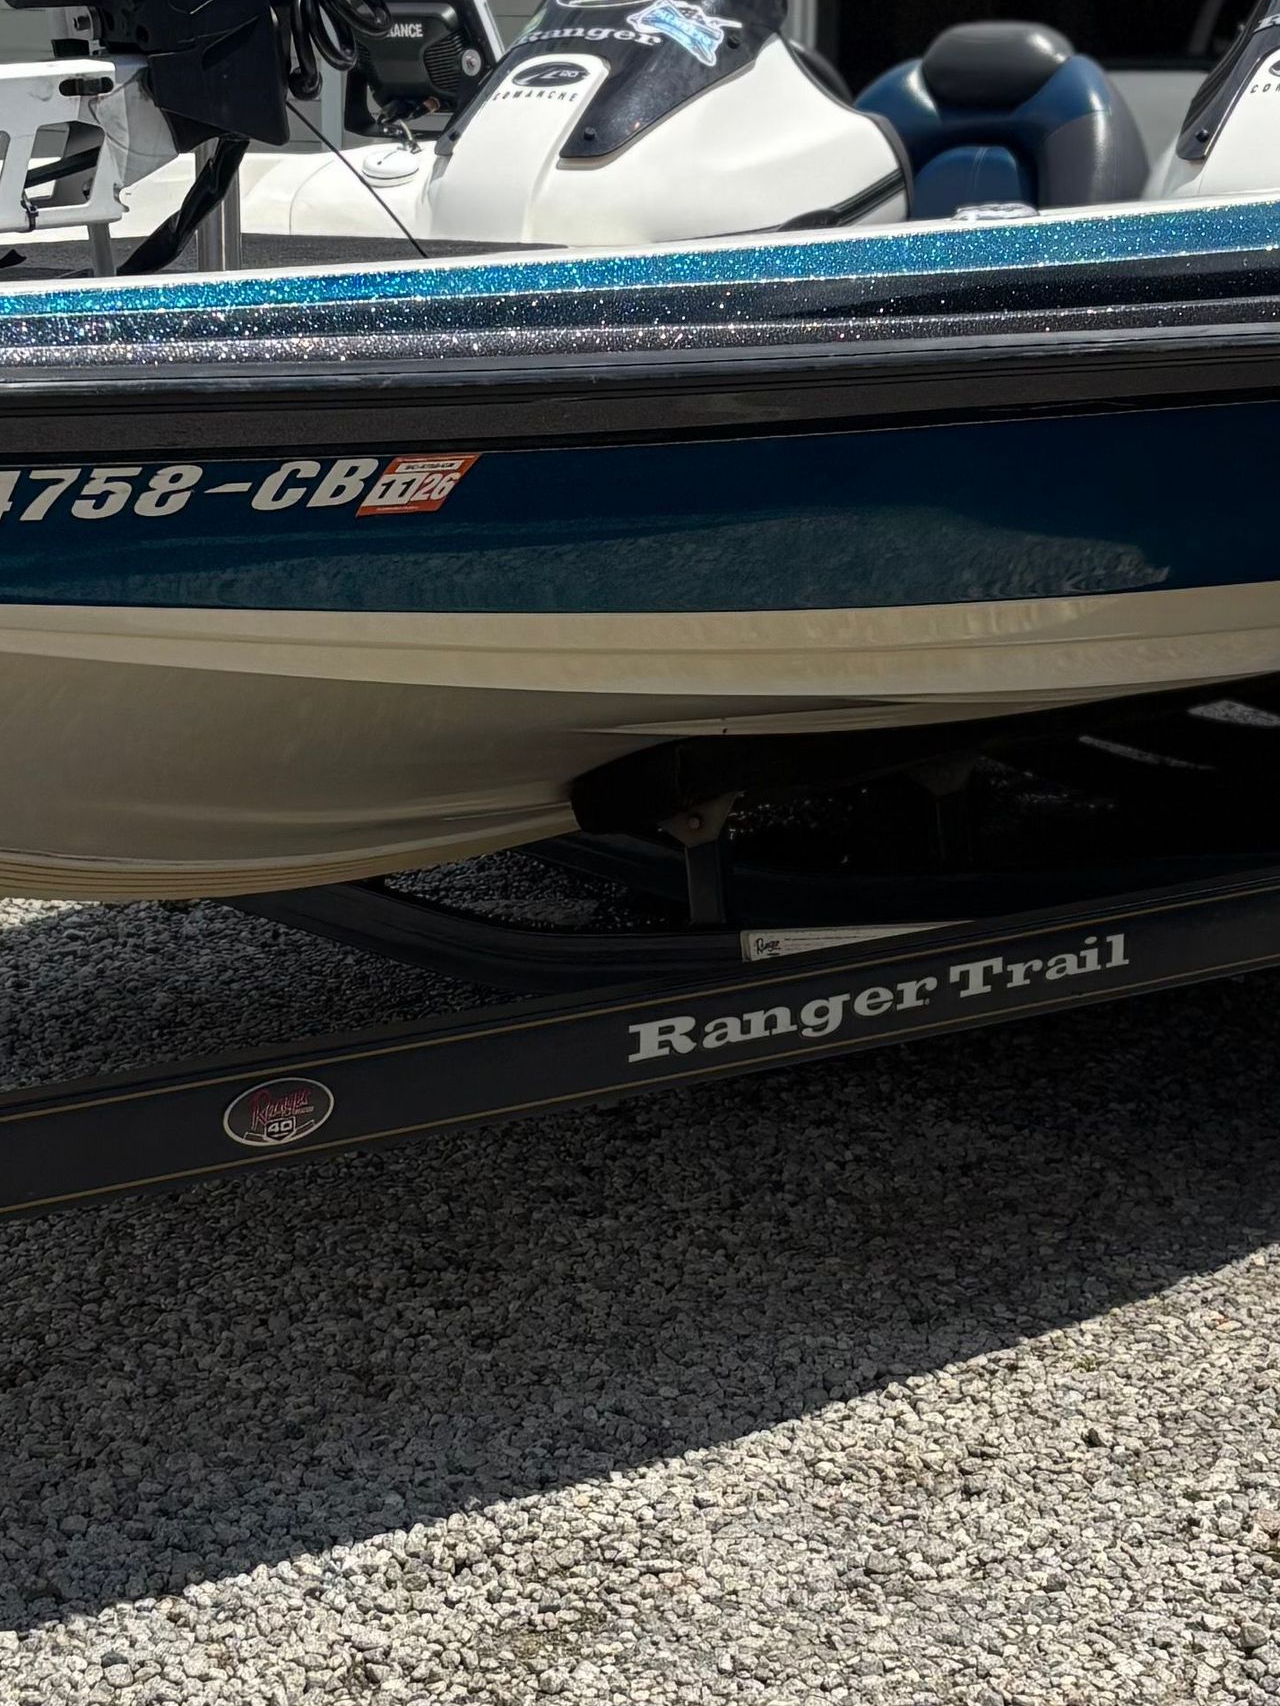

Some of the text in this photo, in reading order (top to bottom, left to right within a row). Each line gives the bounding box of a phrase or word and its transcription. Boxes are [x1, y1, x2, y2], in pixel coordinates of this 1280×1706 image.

[385, 23, 423, 38] ANCE
[378, 472, 461, 501] 11 26
[627, 933, 1130, 1064] Ranger Trail
[267, 1119, 293, 1134] 40
